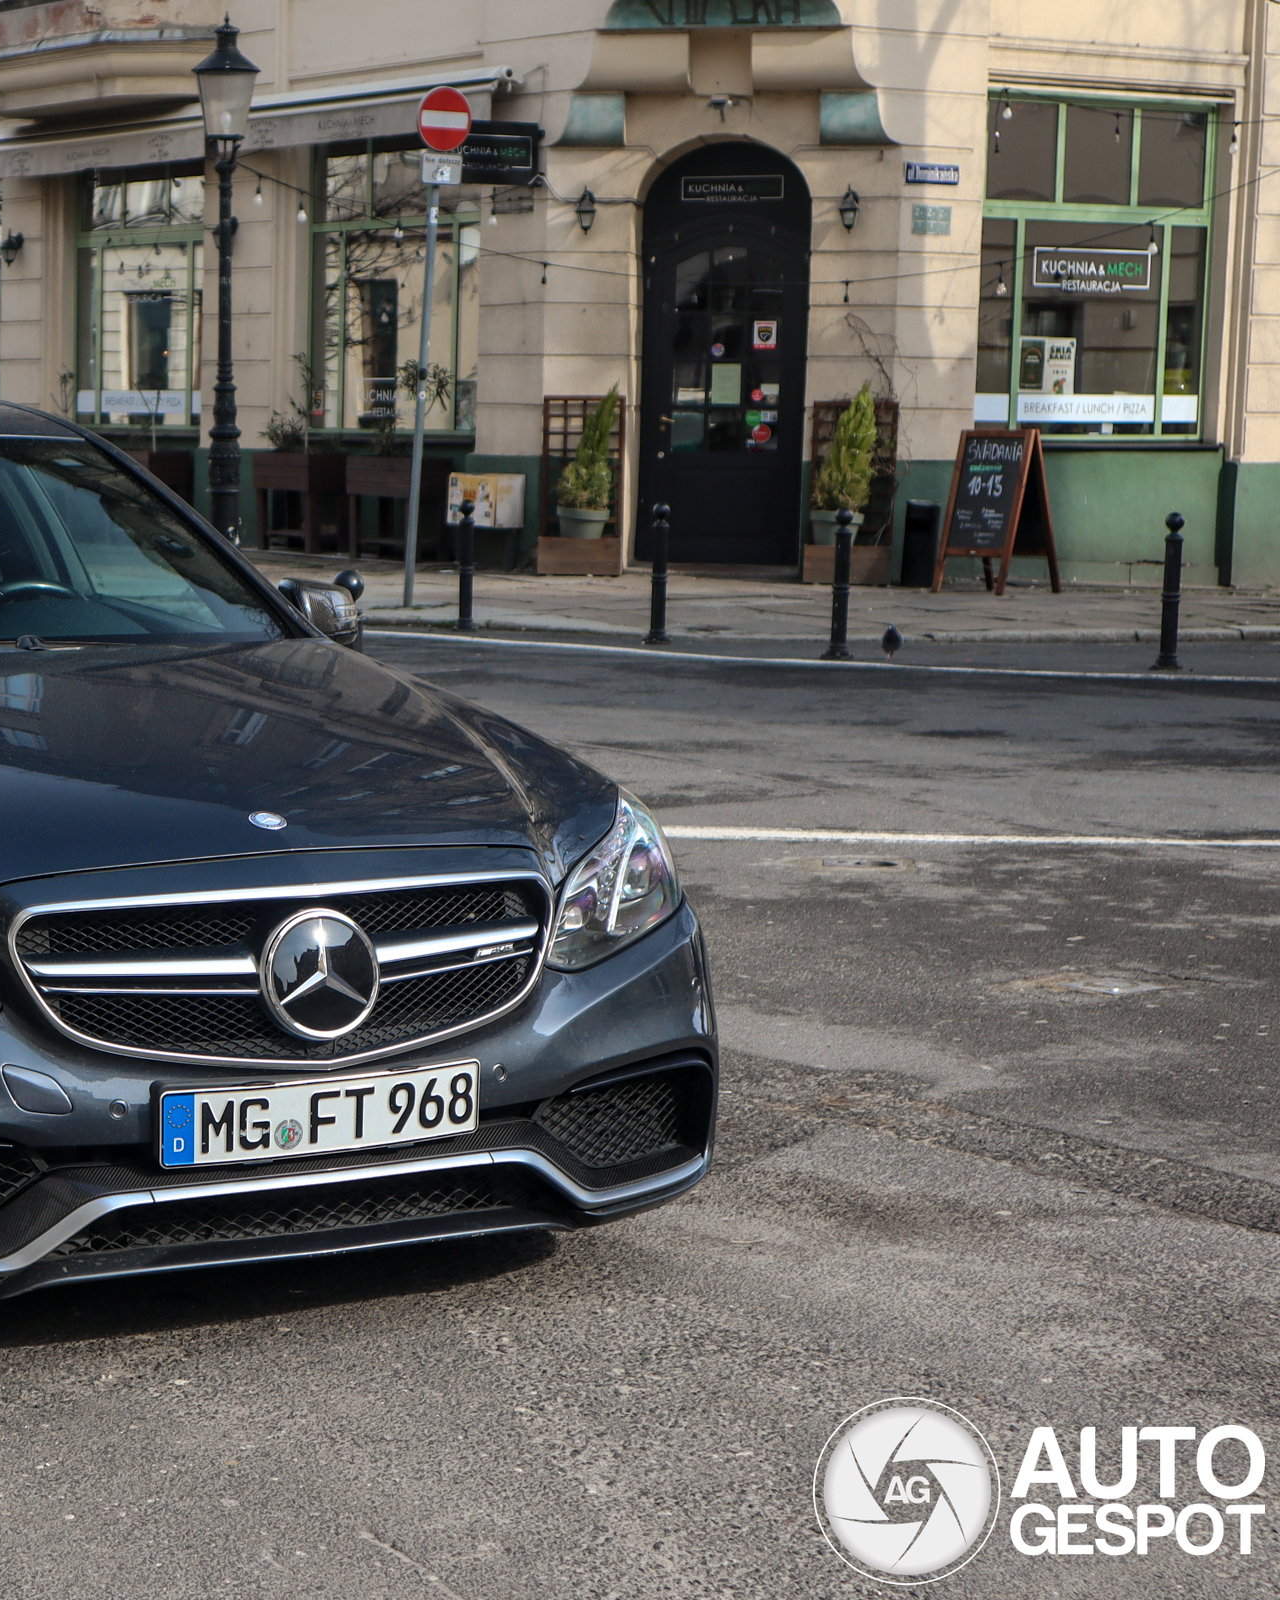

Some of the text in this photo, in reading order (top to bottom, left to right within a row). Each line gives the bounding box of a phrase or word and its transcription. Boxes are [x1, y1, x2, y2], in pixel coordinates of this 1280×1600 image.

[354, 114, 375, 126] MECH
[500, 147, 527, 157] MECH
[438, 157, 460, 166] dotyczy
[688, 183, 736, 193] KUCHNIA
[738, 184, 745, 192] &
[706, 194, 758, 202] RESTAURACJA
[1041, 259, 1143, 277] KUCHNIA & MECH
[153, 277, 176, 288] MECH
[1062, 280, 1121, 293] RESTAURACJA
[357, 389, 398, 401] UCHNIA
[166, 397, 181, 407] PIZZA
[1024, 402, 1074, 414] BREAKFAST
[1082, 402, 1115, 414] LUNCH
[1123, 402, 1146, 414] PIZZA
[968, 439, 1023, 462] ŚNIADANIA
[968, 475, 1003, 497] 10-15
[201, 1072, 474, 1153] MG FT 968
[173, 1137, 185, 1152] D
